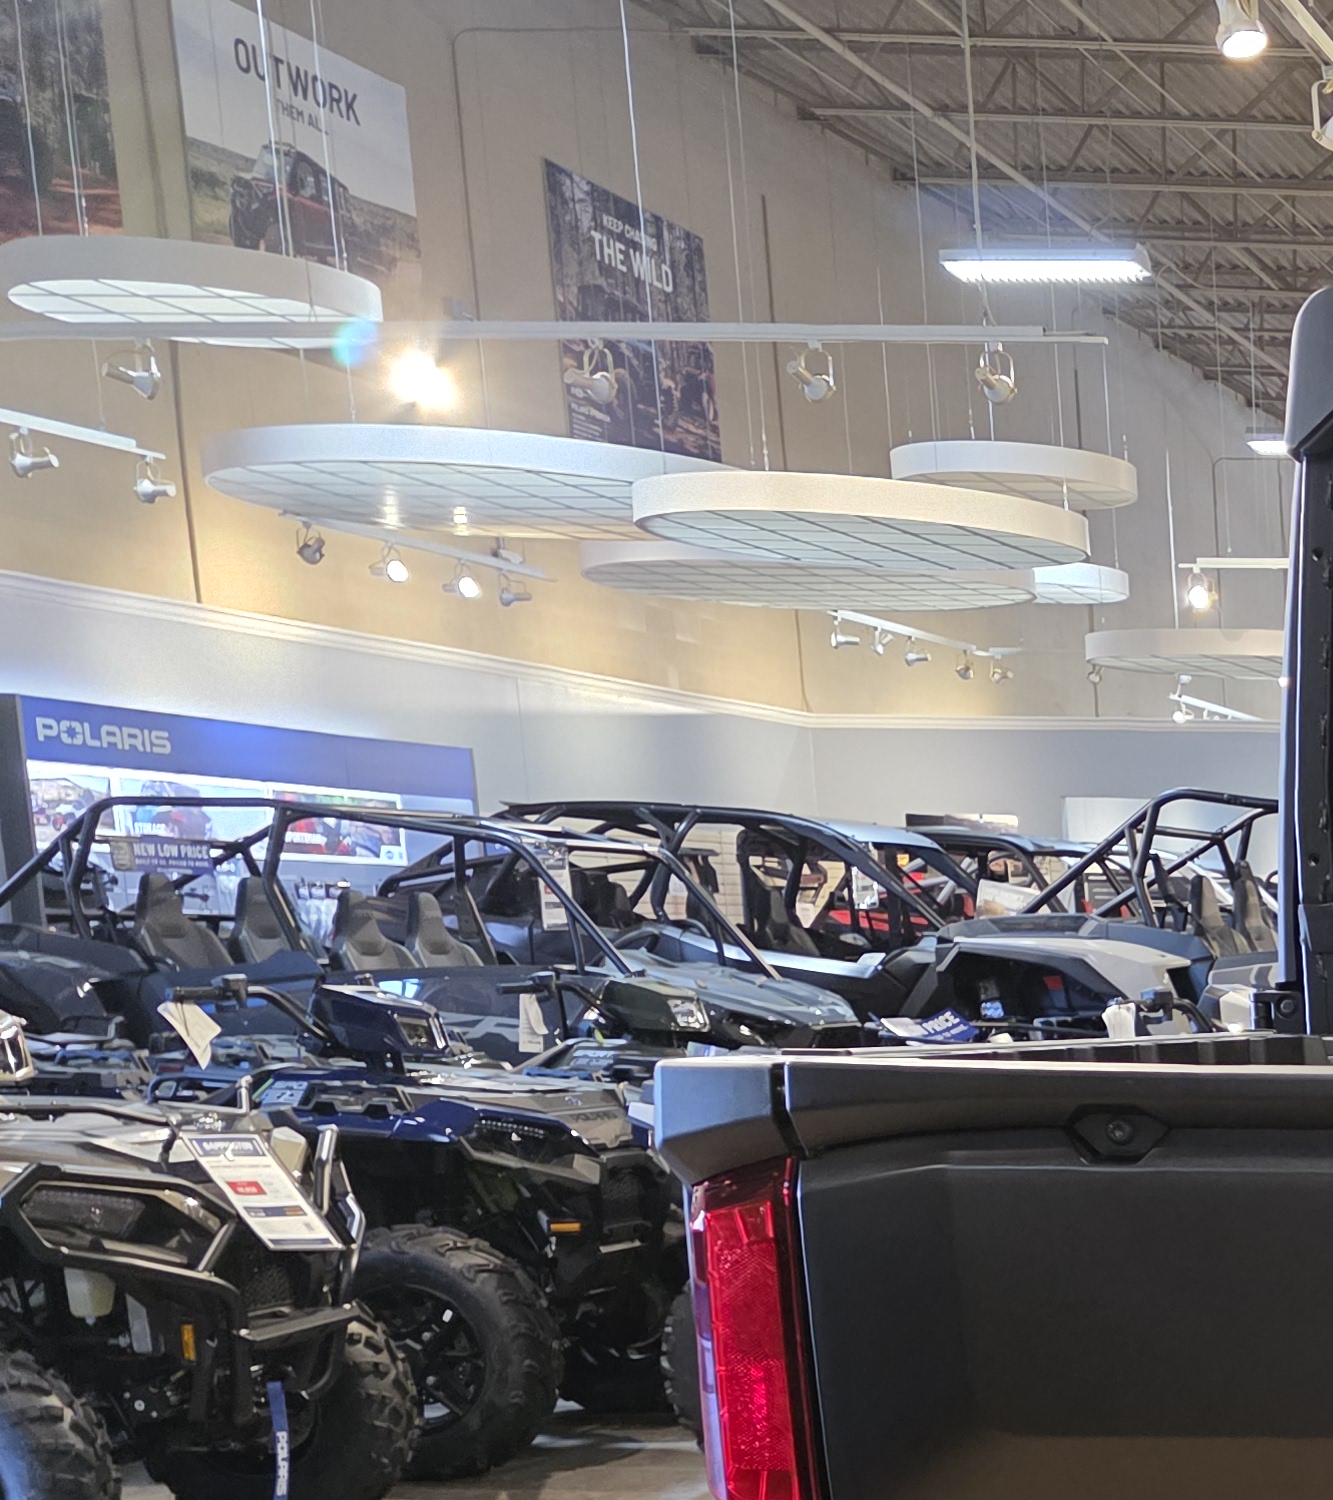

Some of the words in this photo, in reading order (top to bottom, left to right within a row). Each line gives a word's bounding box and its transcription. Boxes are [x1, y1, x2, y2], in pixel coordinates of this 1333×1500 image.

[234, 38, 361, 127] OUTWORK
[590, 229, 627, 273] THE
[629, 248, 673, 293] WILD
[35, 716, 172, 755] POLARIS
[133, 843, 155, 857] NEW
[157, 843, 178, 858] LOW
[180, 844, 209, 860] PRICE
[276, 1430, 289, 1496] POLARIS
